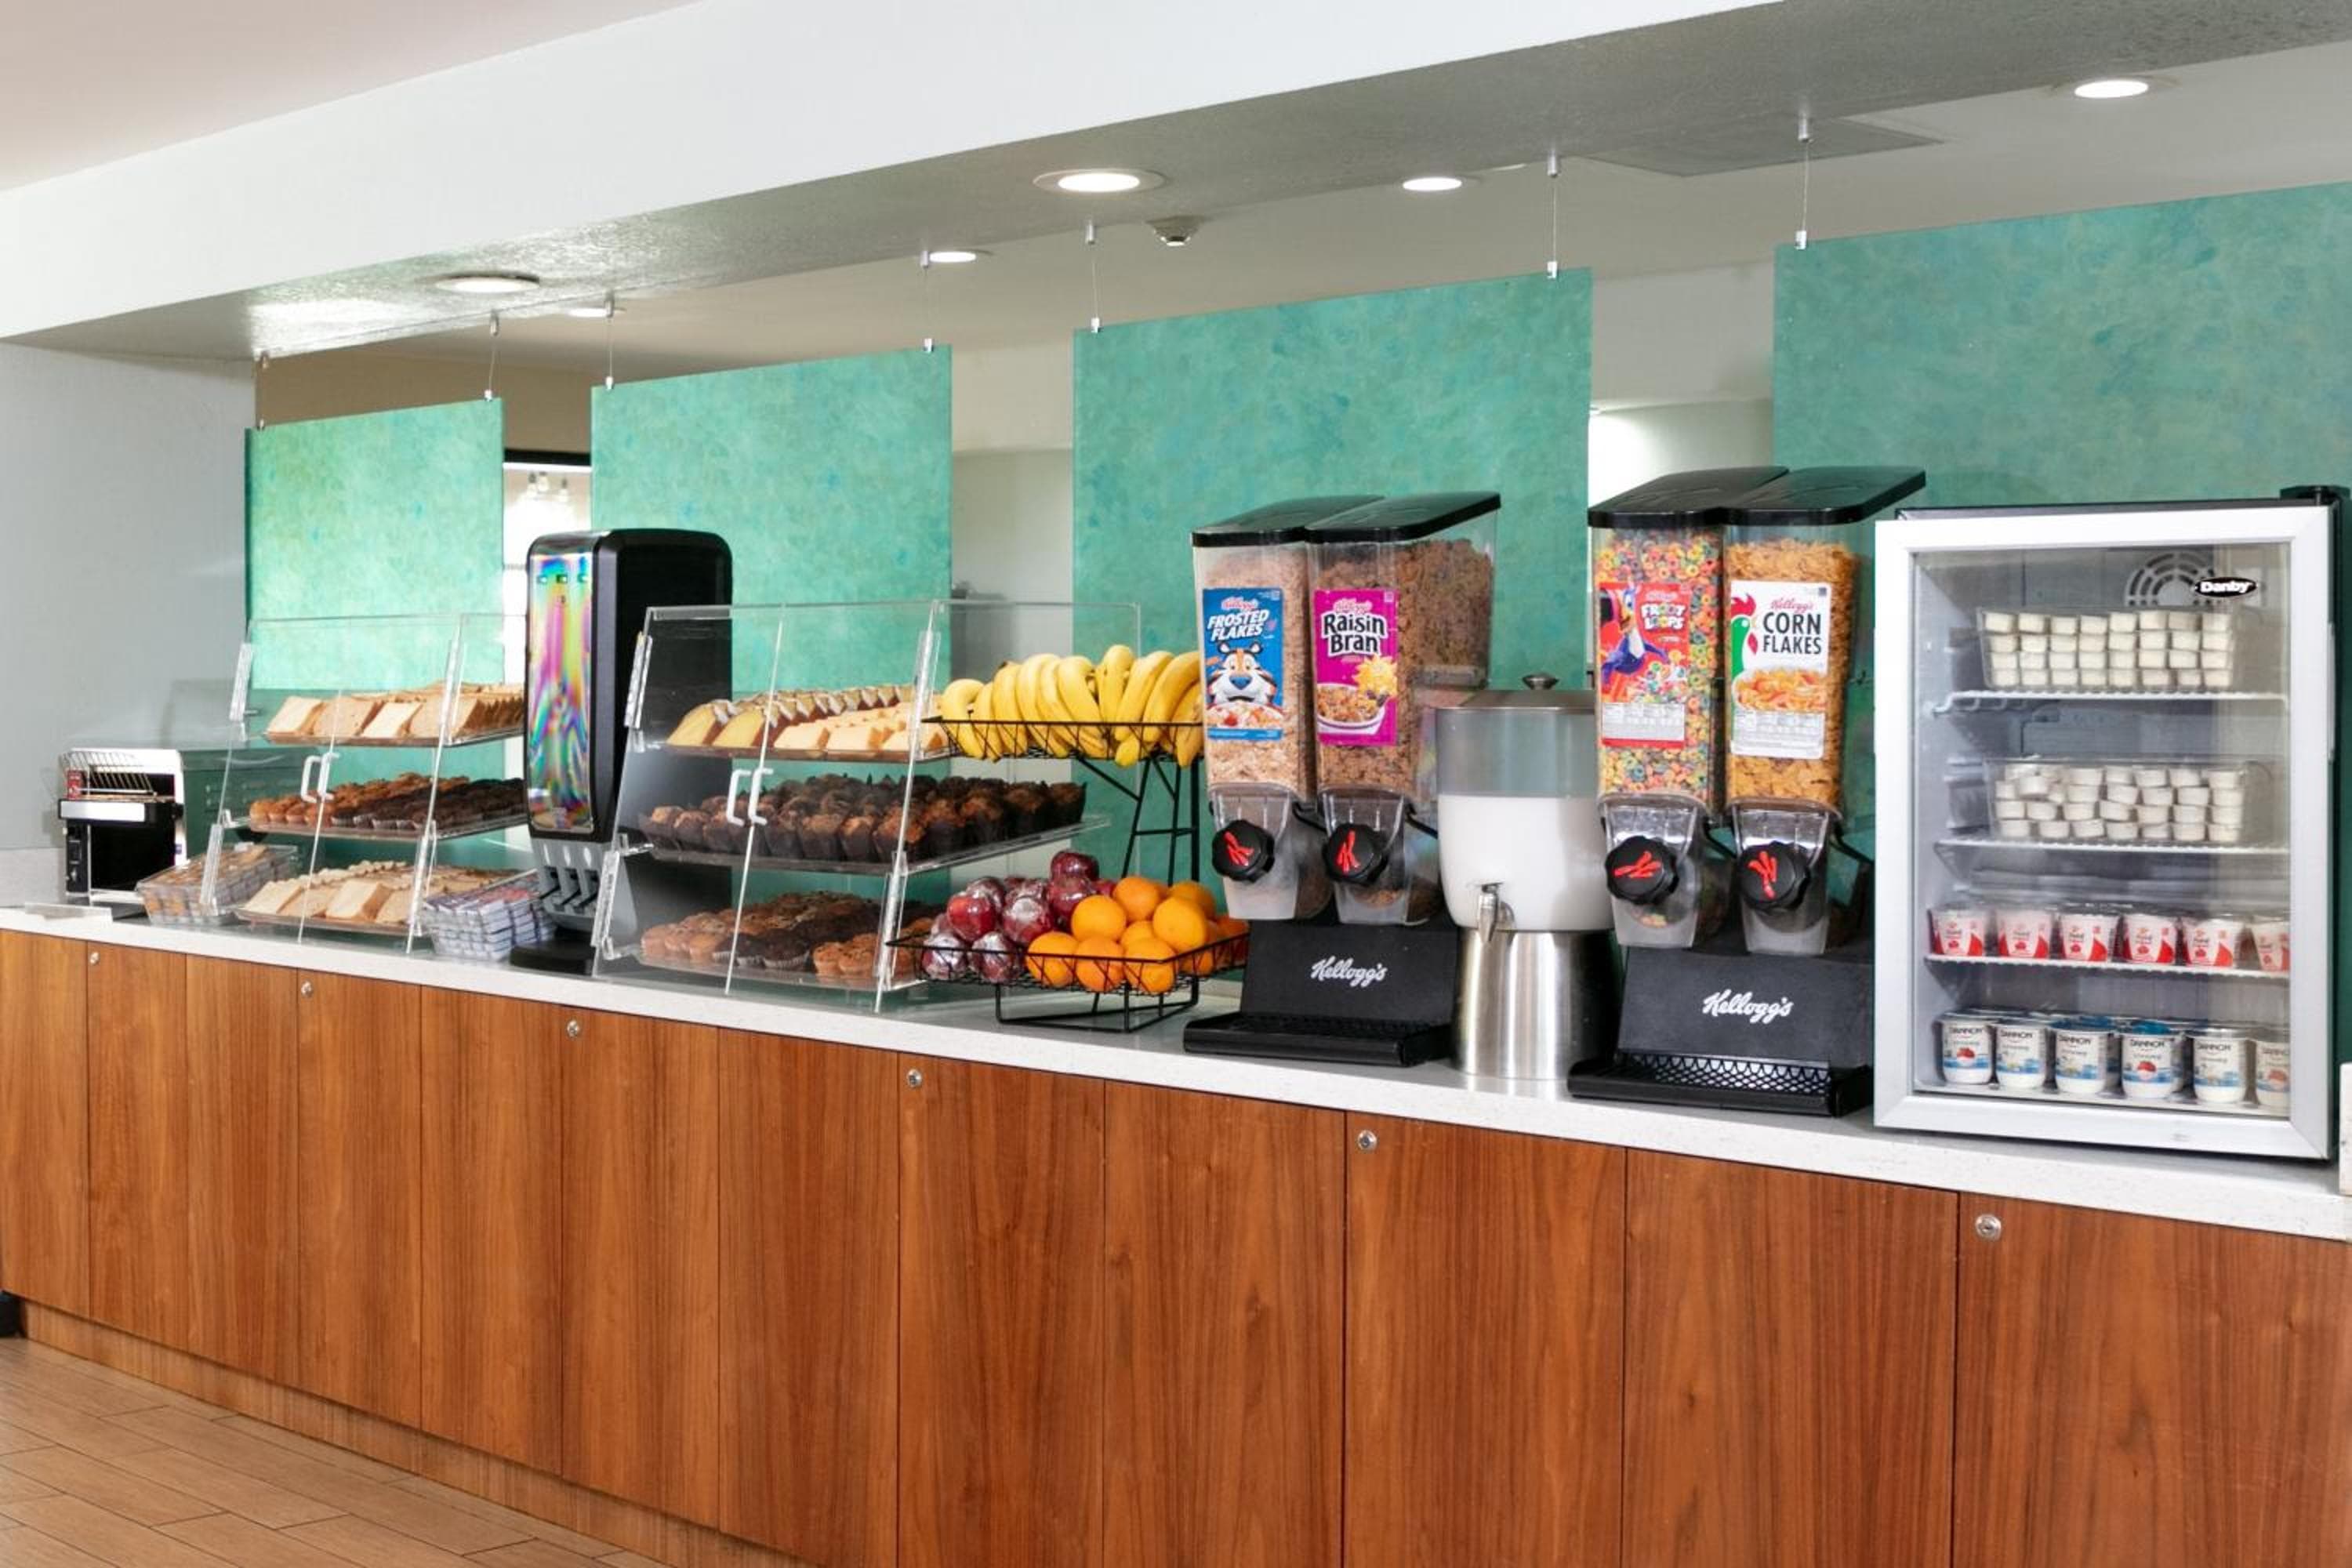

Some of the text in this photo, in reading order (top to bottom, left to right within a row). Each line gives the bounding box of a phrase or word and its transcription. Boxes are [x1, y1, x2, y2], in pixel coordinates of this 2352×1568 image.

[2200, 581, 2254, 593] Danby
[1770, 597, 1813, 614] Kellogg's
[1207, 609, 1269, 630] FROSTED
[1323, 614, 1385, 636] Raisin
[1762, 612, 1821, 635] CORN
[1210, 625, 1263, 641] FLAKES
[1330, 633, 1378, 653] Bran
[1762, 634, 1822, 655] FLAKES
[1310, 955, 1388, 987] Kellogg's
[1702, 989, 1794, 1024] Kellogg's
[2000, 1029, 2033, 1039] DANNON
[2058, 1034, 2092, 1044] DANNON
[2131, 1039, 2165, 1048] DANNON
